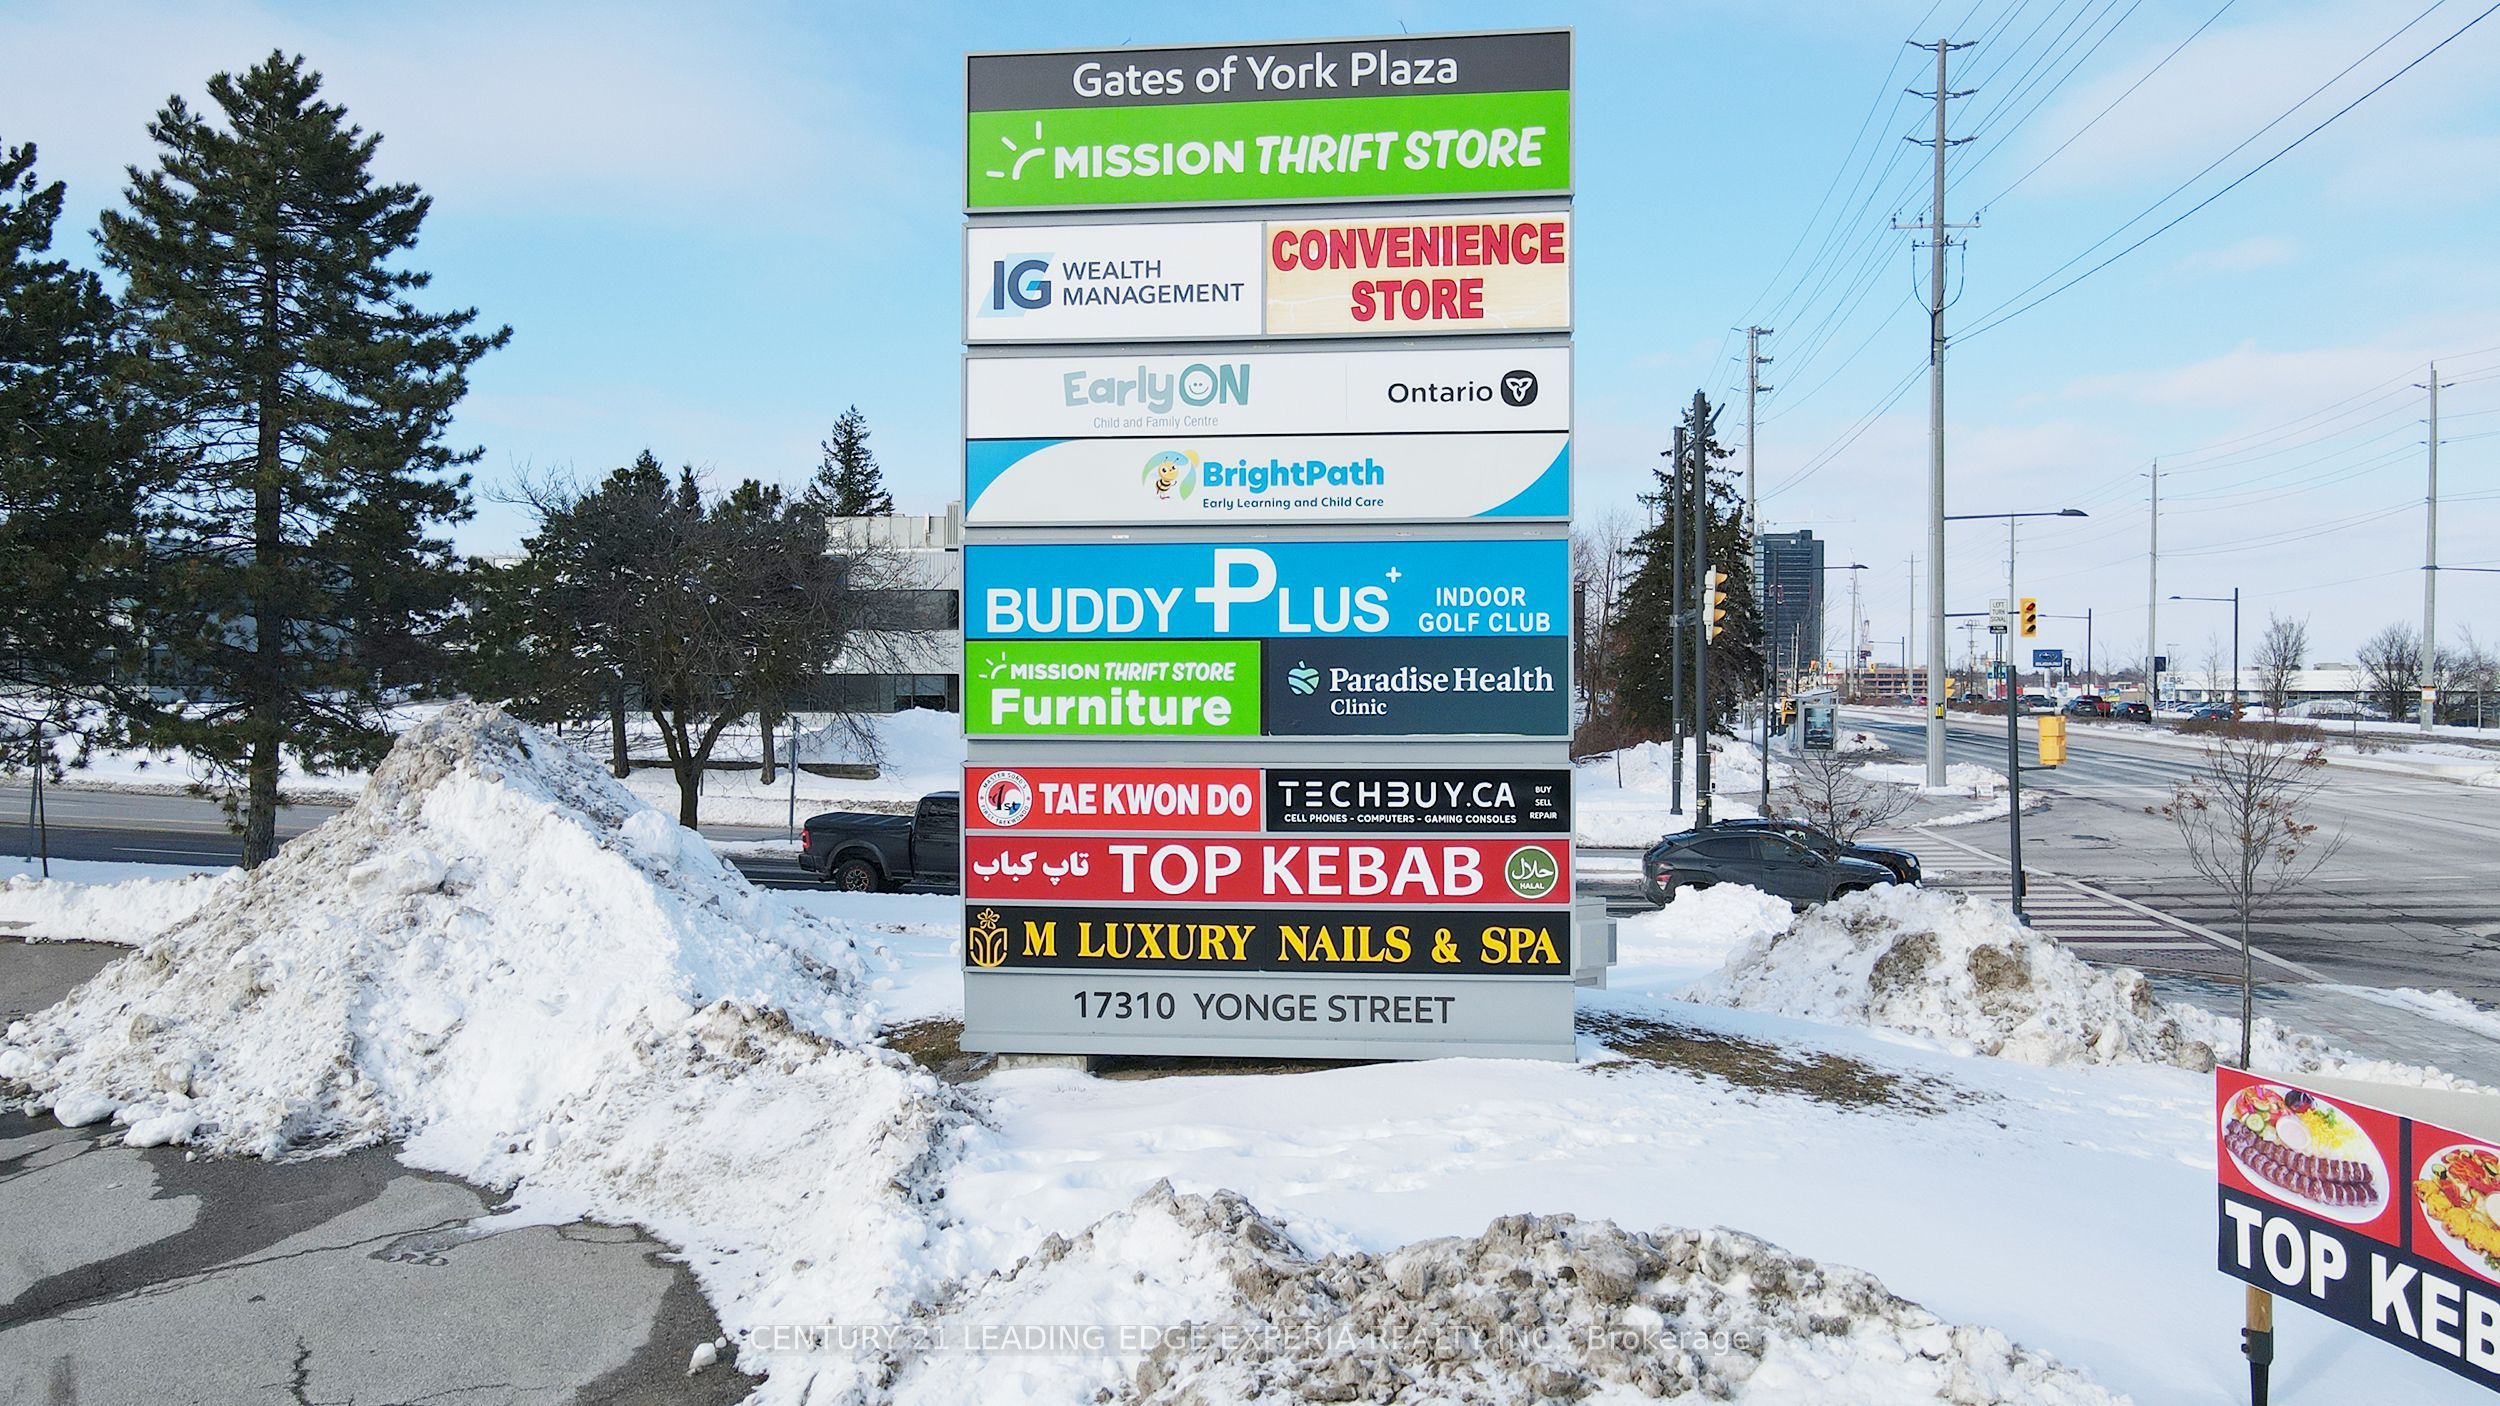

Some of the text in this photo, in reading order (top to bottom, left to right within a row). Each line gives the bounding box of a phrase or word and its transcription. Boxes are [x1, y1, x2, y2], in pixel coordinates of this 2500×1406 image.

[1072, 51, 1458, 98] Gates of York Plaza
[1054, 126, 1547, 179] MISSION THRIFT STORE
[1271, 222, 1565, 271] CONVENIENCE
[993, 259, 1052, 310] IG
[1062, 260, 1162, 280] WEALTH
[1063, 283, 1244, 306] MANAGEMENT
[1351, 278, 1484, 321] STORE
[1387, 382, 1493, 404] Ontario
[1093, 415, 1218, 429] Child and Family Centre
[1203, 458, 1384, 494] BrightPath
[1203, 497, 1384, 510] Early Learning and Child Care
[986, 587, 1184, 633] BUDDY
[1436, 587, 1526, 607] INDOOR
[1418, 612, 1551, 633] GOLF CLUB
[1011, 661, 1236, 682] MISSION THRIFT STORE
[1329, 666, 1554, 693] Paradise Health
[991, 687, 1232, 727] Furniture
[1331, 698, 1388, 717] Clinic
[1038, 783, 1253, 817] TAE KWON DO
[1278, 781, 1516, 808] TECHBUY.CA
[1284, 814, 1307, 823] CELL
[1309, 814, 1347, 824] PHONES
[1357, 814, 1415, 824] COMPUTERS
[1424, 814, 1462, 824] GAMING
[1465, 814, 1517, 824] CONSOLES
[1529, 812, 1557, 820] REPAIR
[973, 851, 1090, 886] تاپ کباب
[1109, 845, 1484, 897] TOP KEBAB
[1512, 857, 1554, 880] حلال
[1022, 921, 1561, 964] M LUXURY NAILS & SPA
[1073, 990, 1455, 1024] 17310 YONGE STREET
[2225, 1199, 2500, 1375] TOP KEB
